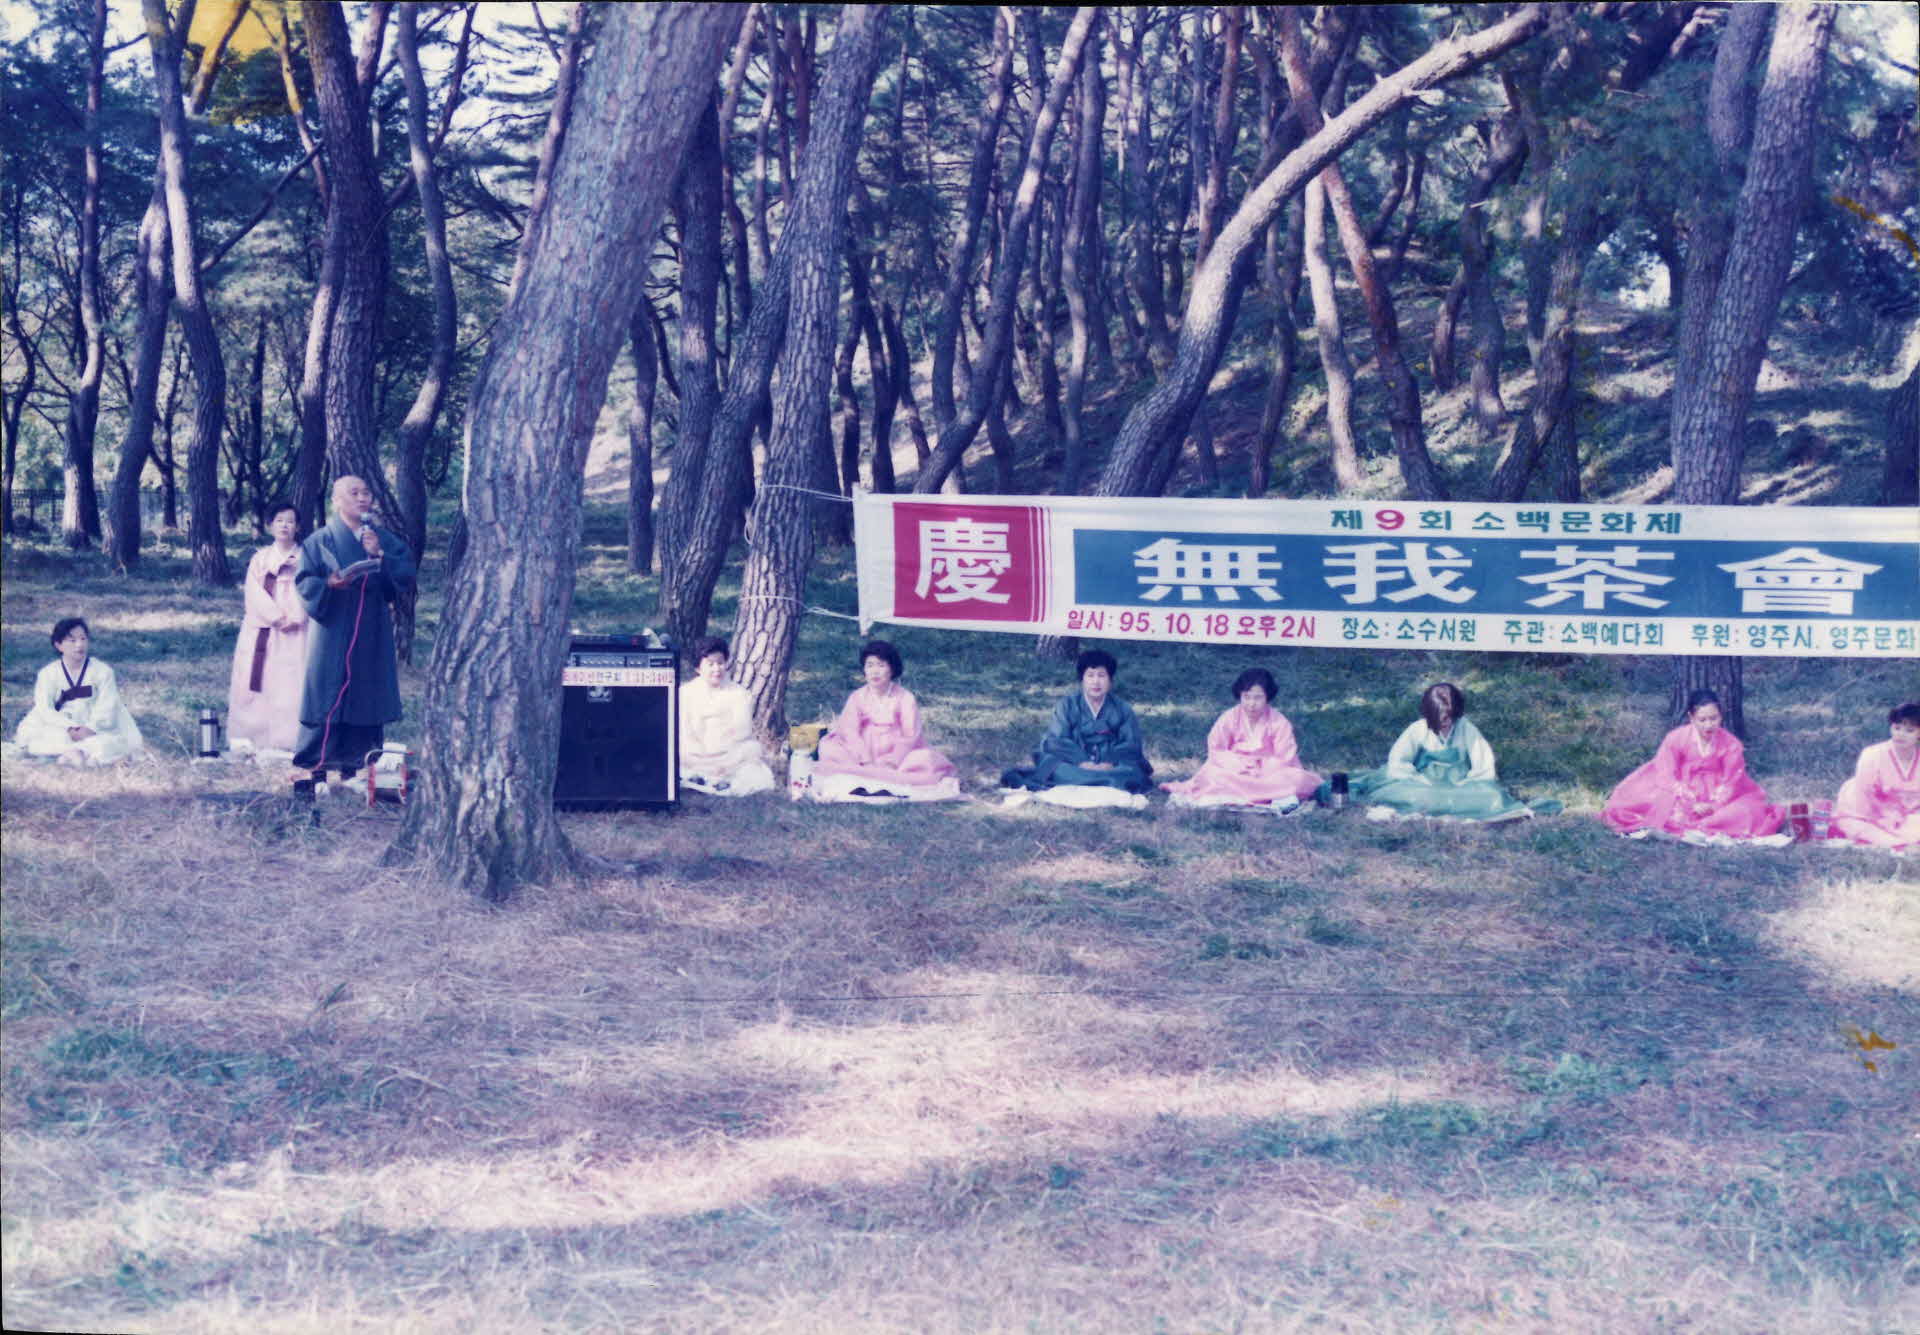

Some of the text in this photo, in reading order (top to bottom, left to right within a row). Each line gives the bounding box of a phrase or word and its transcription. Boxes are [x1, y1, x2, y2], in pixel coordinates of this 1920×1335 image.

[1329, 508, 1682, 535] 제9회 소백문화제
[915, 518, 1011, 604] 慶
